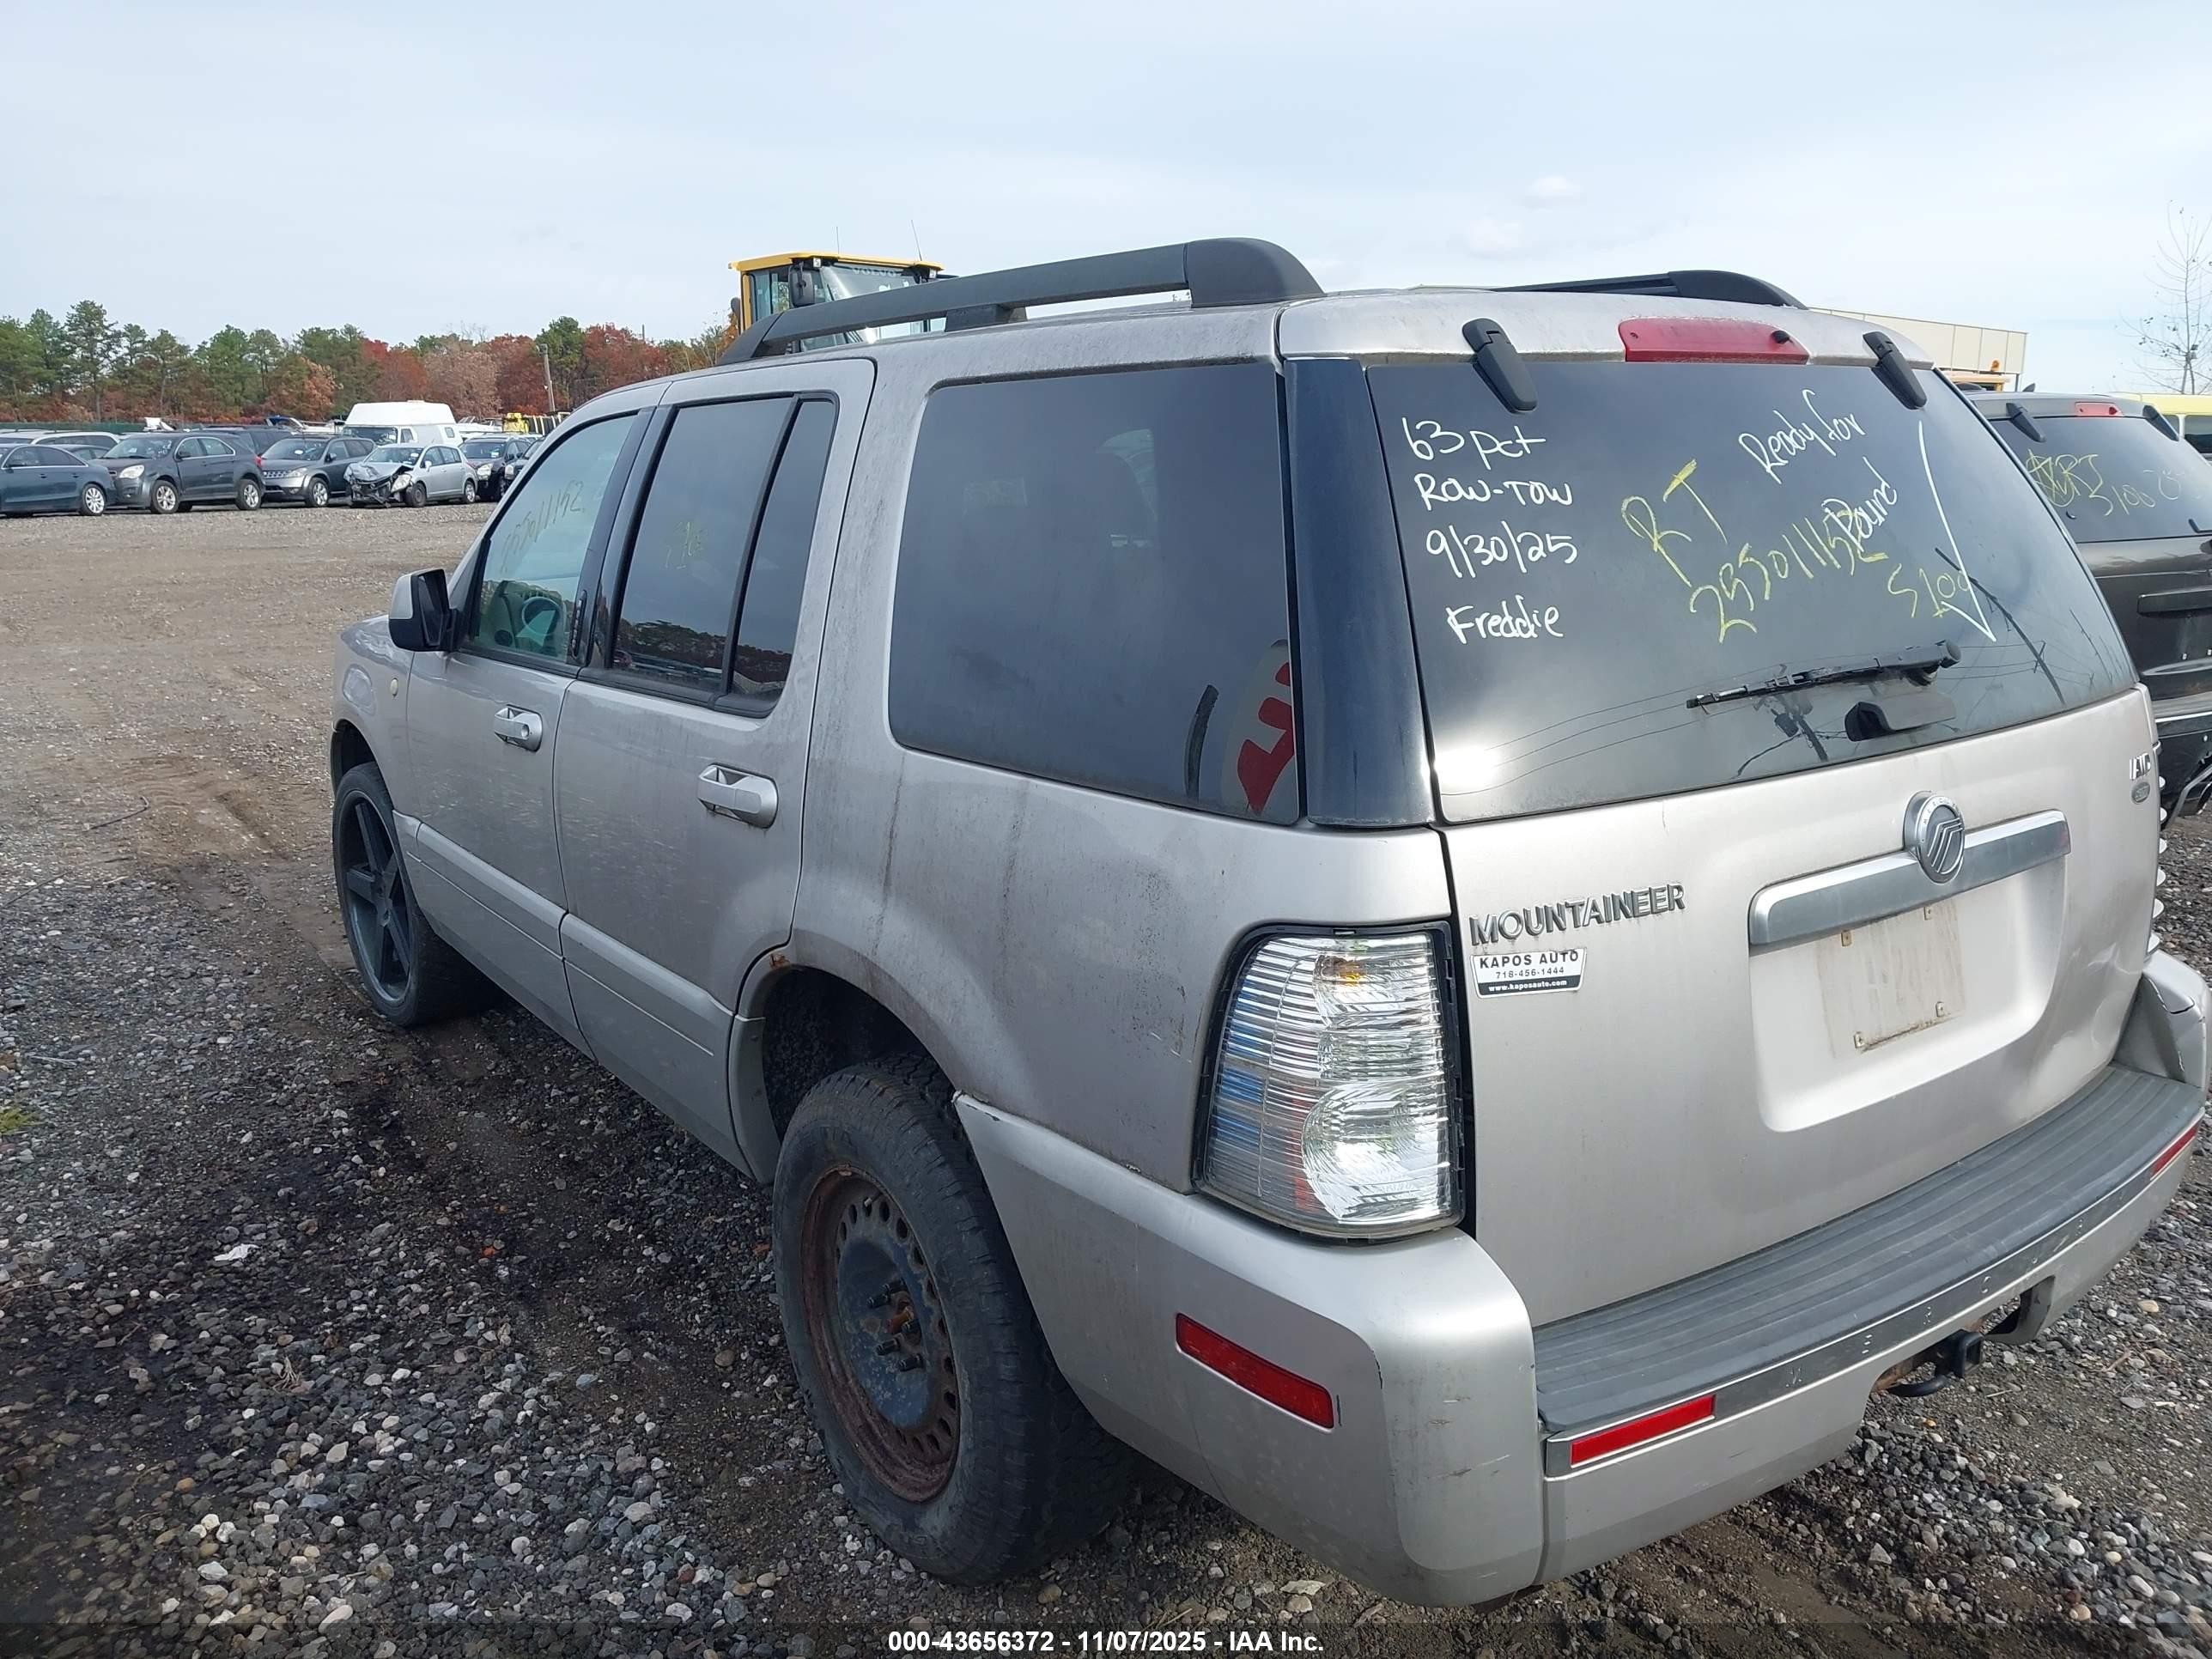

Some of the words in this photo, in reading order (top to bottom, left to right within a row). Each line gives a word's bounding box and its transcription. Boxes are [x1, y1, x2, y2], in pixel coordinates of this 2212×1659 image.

[1738, 410, 1837, 484] Ready
[1802, 388, 1866, 441] for
[1425, 520, 1578, 579] 9/30/25
[1445, 593, 1565, 645] Freddie
[1469, 883, 1686, 946] MOUNTAINEER
[1480, 955, 1532, 969] KAPOS
[1540, 949, 1579, 963] AUTO
[1495, 966, 1565, 979] 718-456-1444
[1488, 979, 1568, 992] www.kaposauto.com
